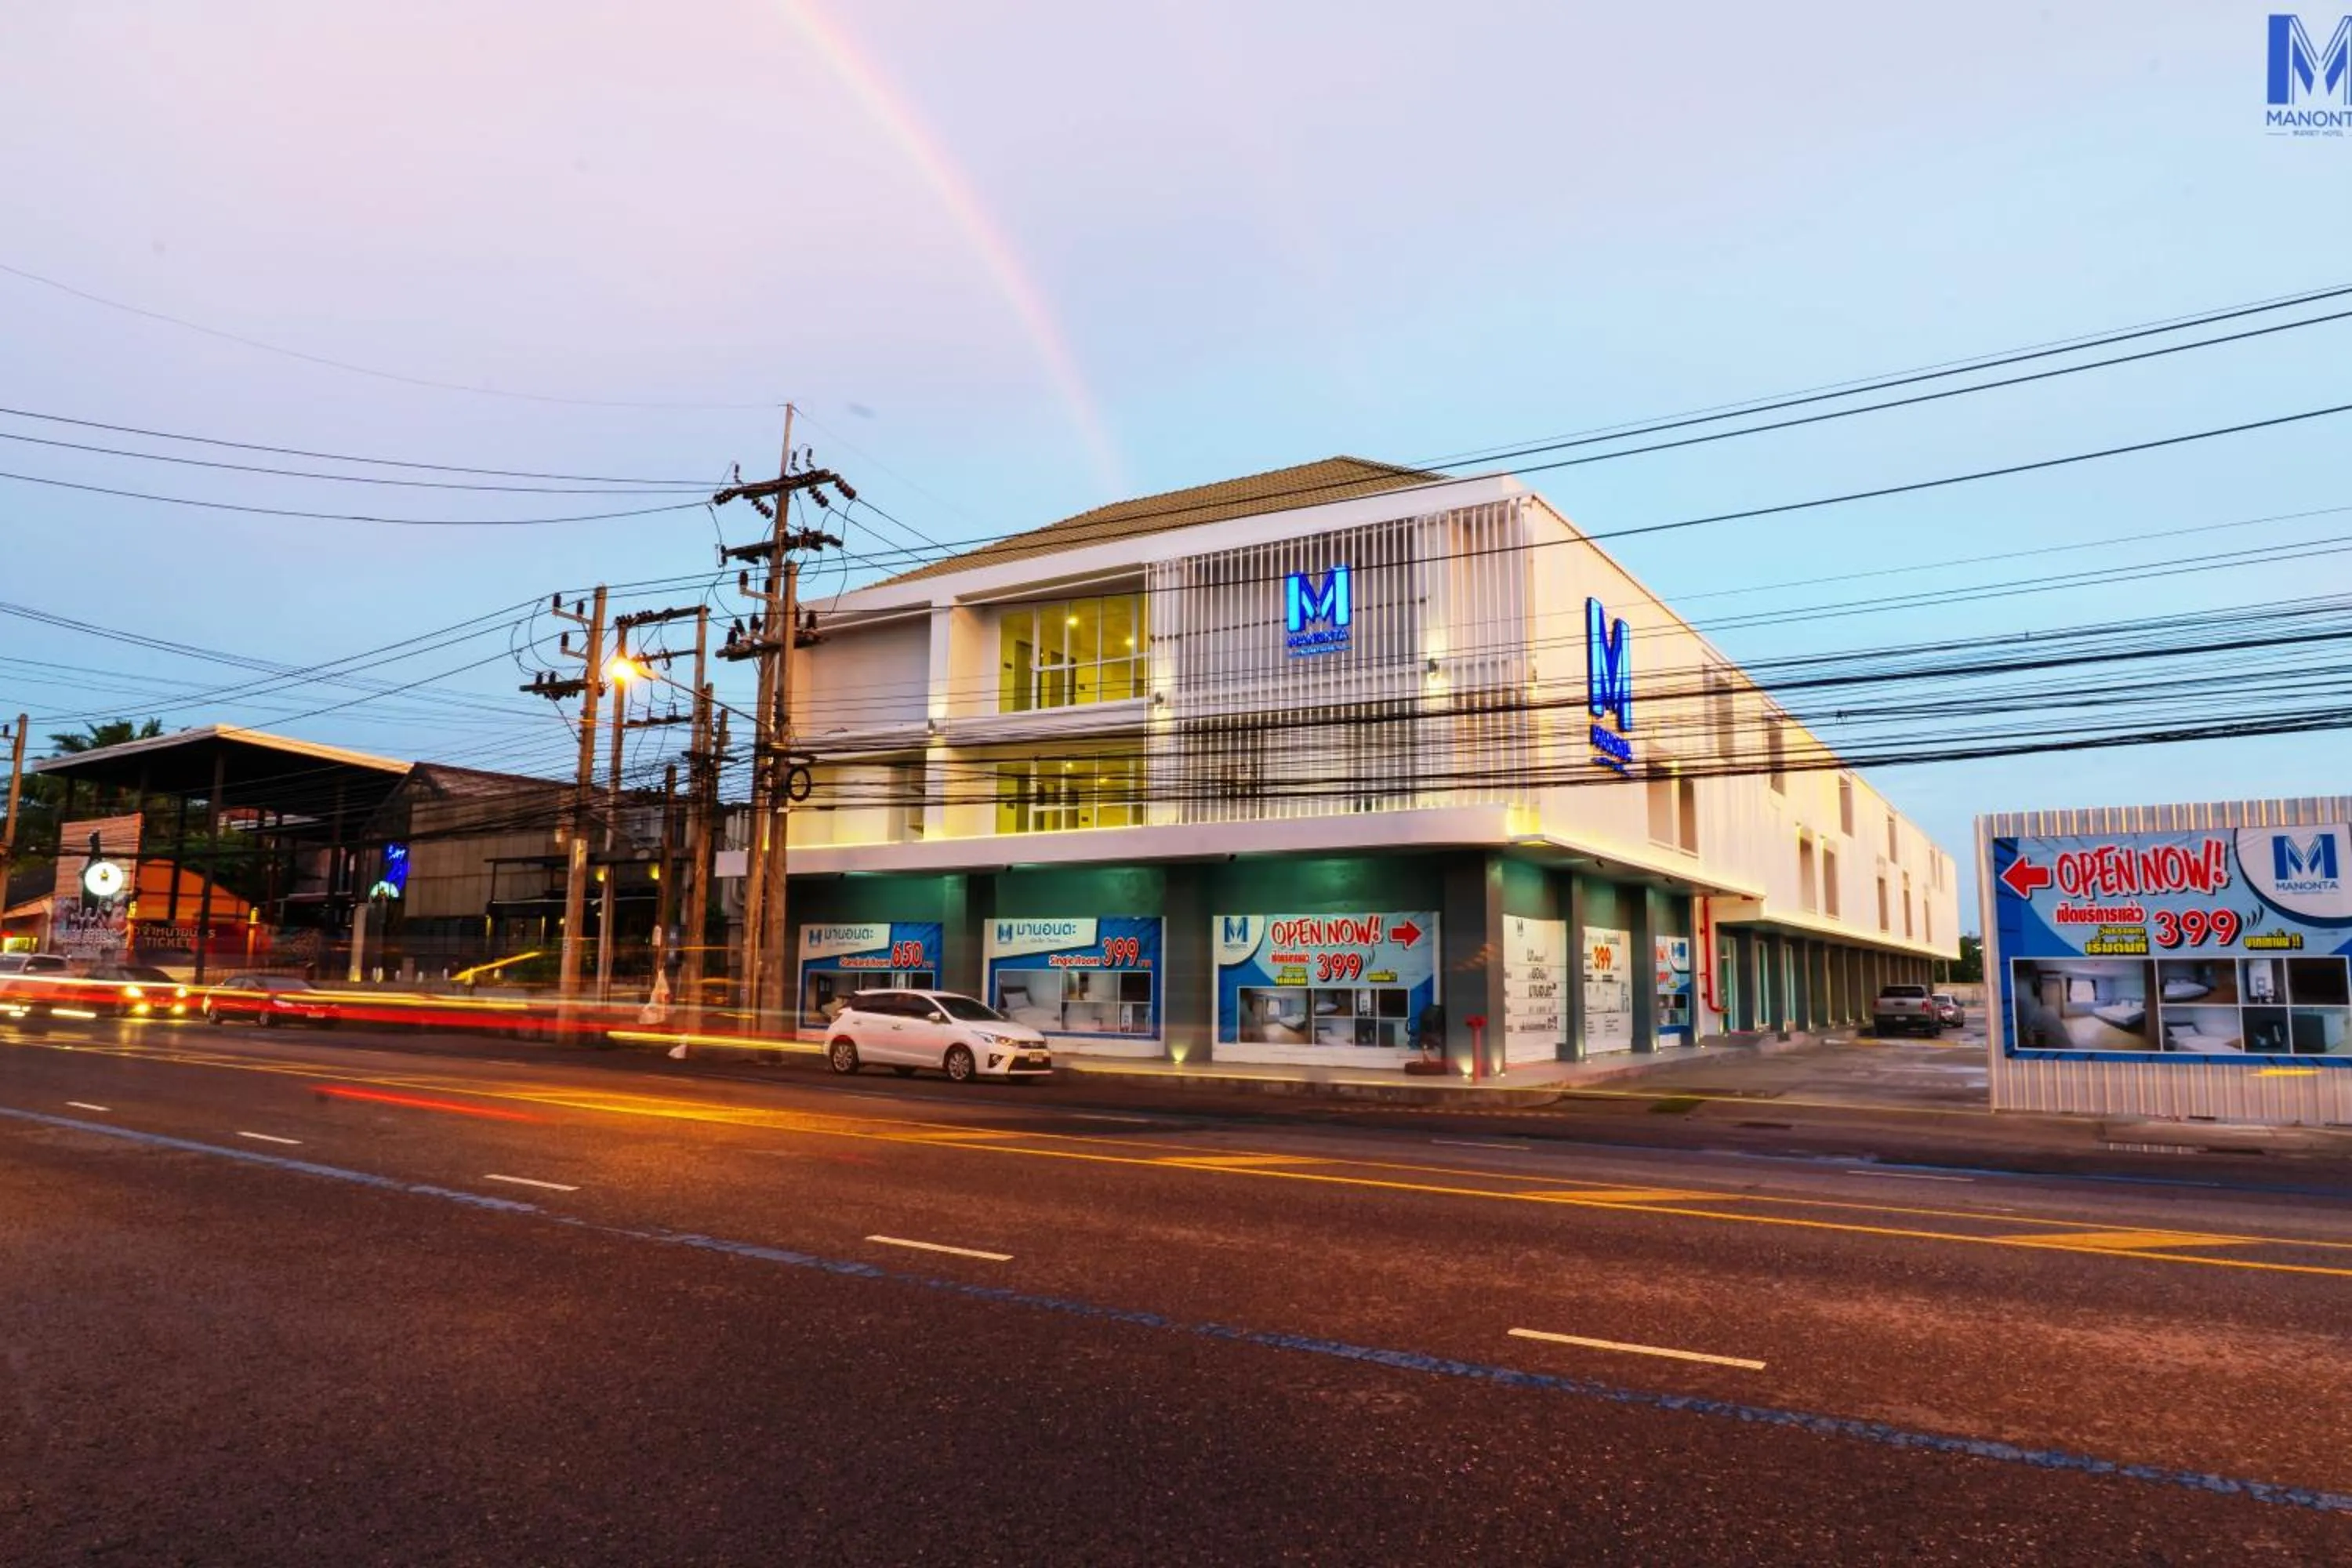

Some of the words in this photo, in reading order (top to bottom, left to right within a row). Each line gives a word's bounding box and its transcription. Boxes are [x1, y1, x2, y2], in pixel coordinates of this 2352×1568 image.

[1287, 565, 1351, 633] M
[2057, 846, 2136, 895] OPEN
[2140, 839, 2224, 892] NOW!
[2272, 834, 2338, 880] M
[2276, 880, 2339, 891] MANONTA
[144, 937, 192, 948] TICKET
[1224, 916, 1248, 942] M
[1271, 918, 1321, 948] OPEN
[1325, 916, 1382, 946] NOW!
[2154, 909, 2238, 946] 399
[891, 941, 923, 967] 650
[1102, 937, 1139, 967] 399
[1316, 953, 1363, 980] 399
